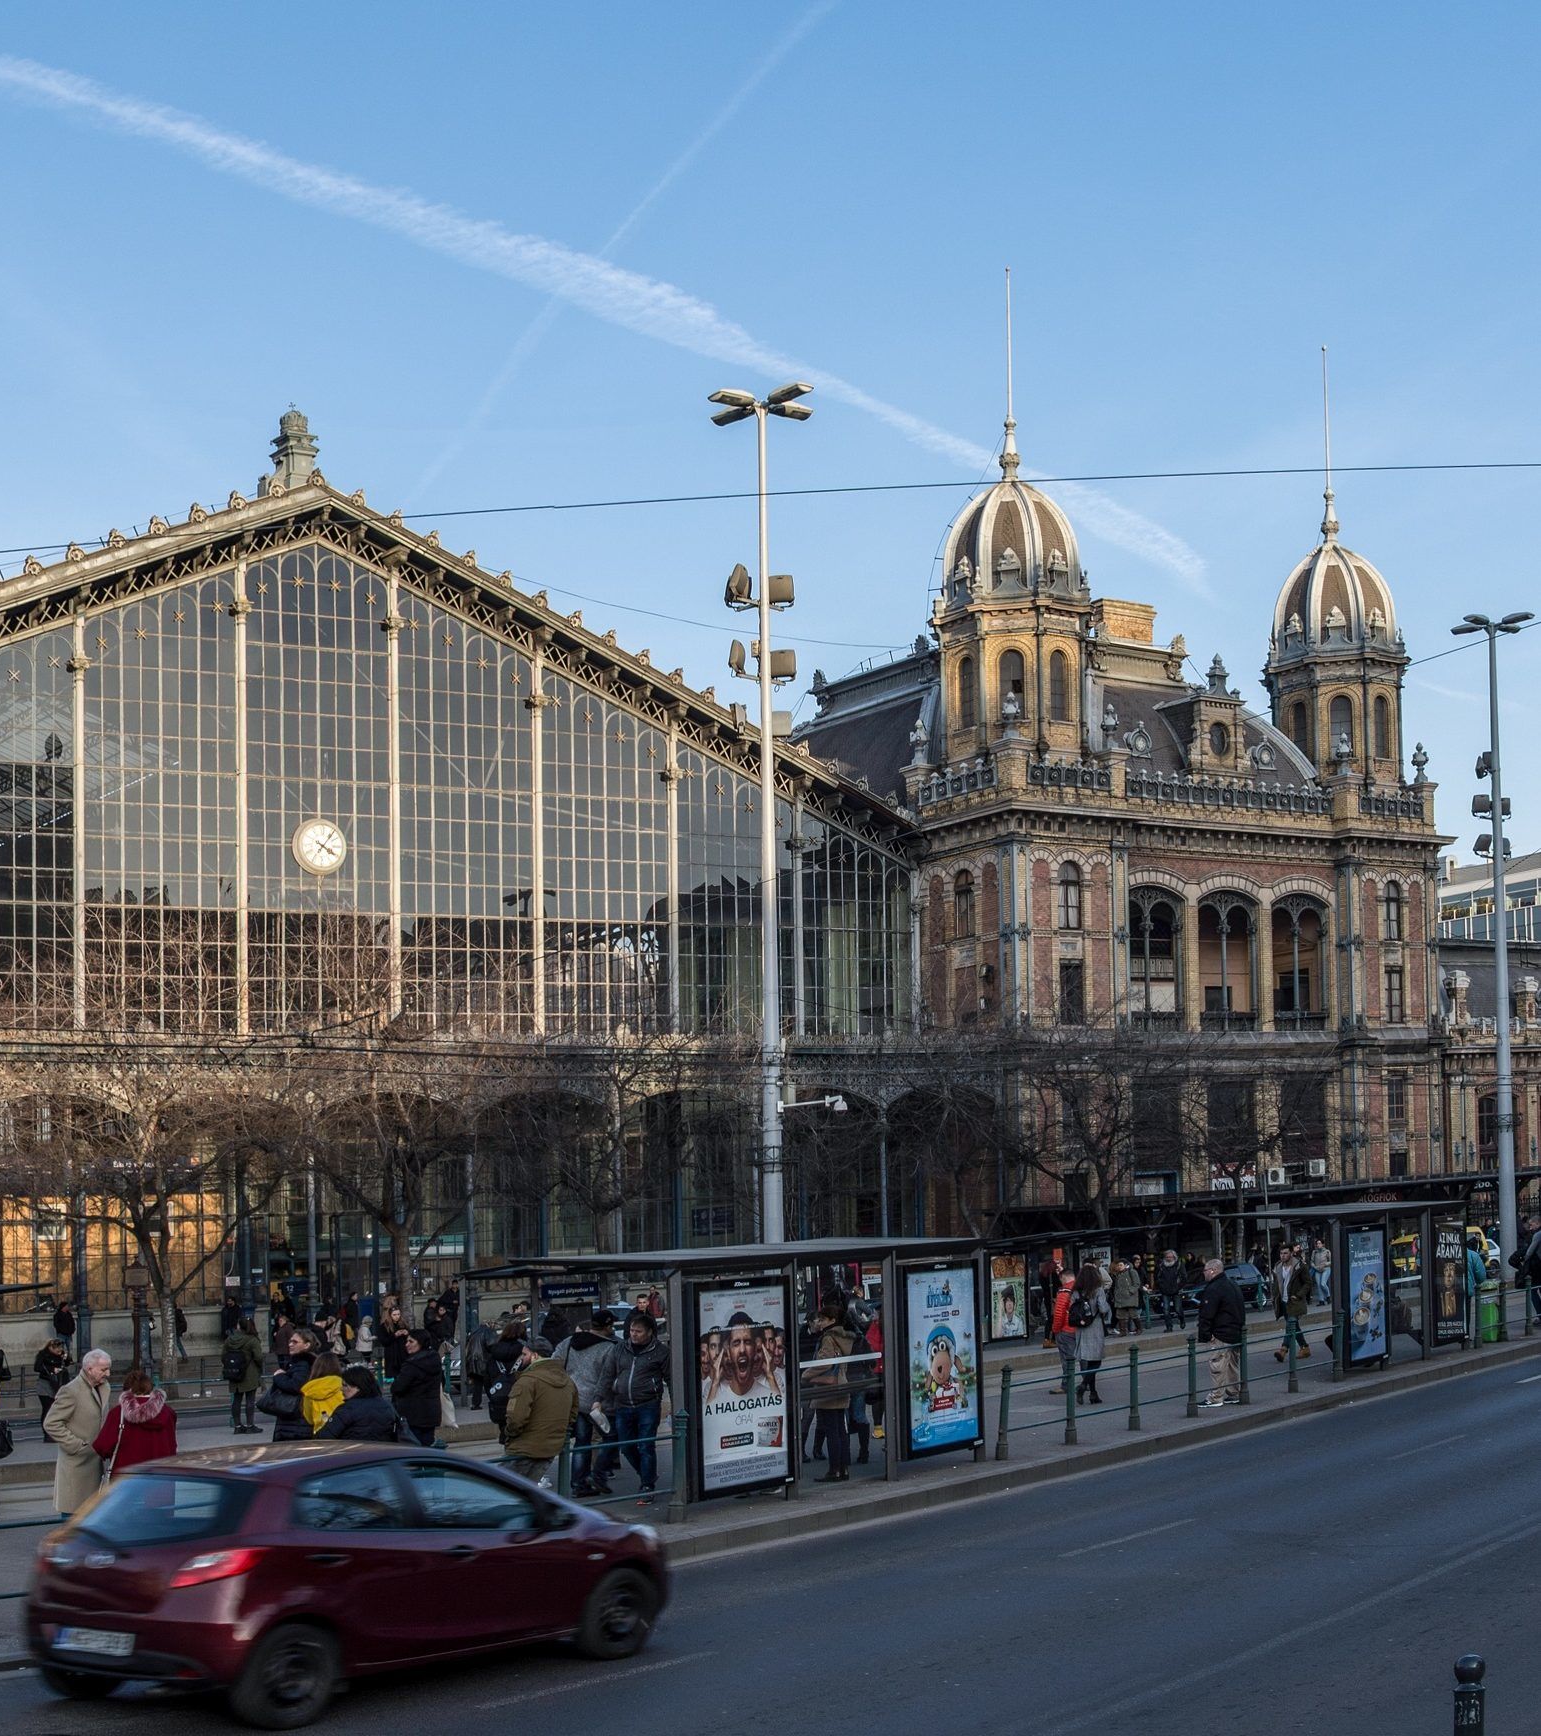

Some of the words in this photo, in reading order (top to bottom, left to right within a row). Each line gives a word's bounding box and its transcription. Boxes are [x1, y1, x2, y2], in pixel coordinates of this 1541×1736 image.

[1436, 1245, 1462, 1258] ARANYA
[705, 1405, 712, 1416] A
[715, 1393, 783, 1415] HALOGATÁS
